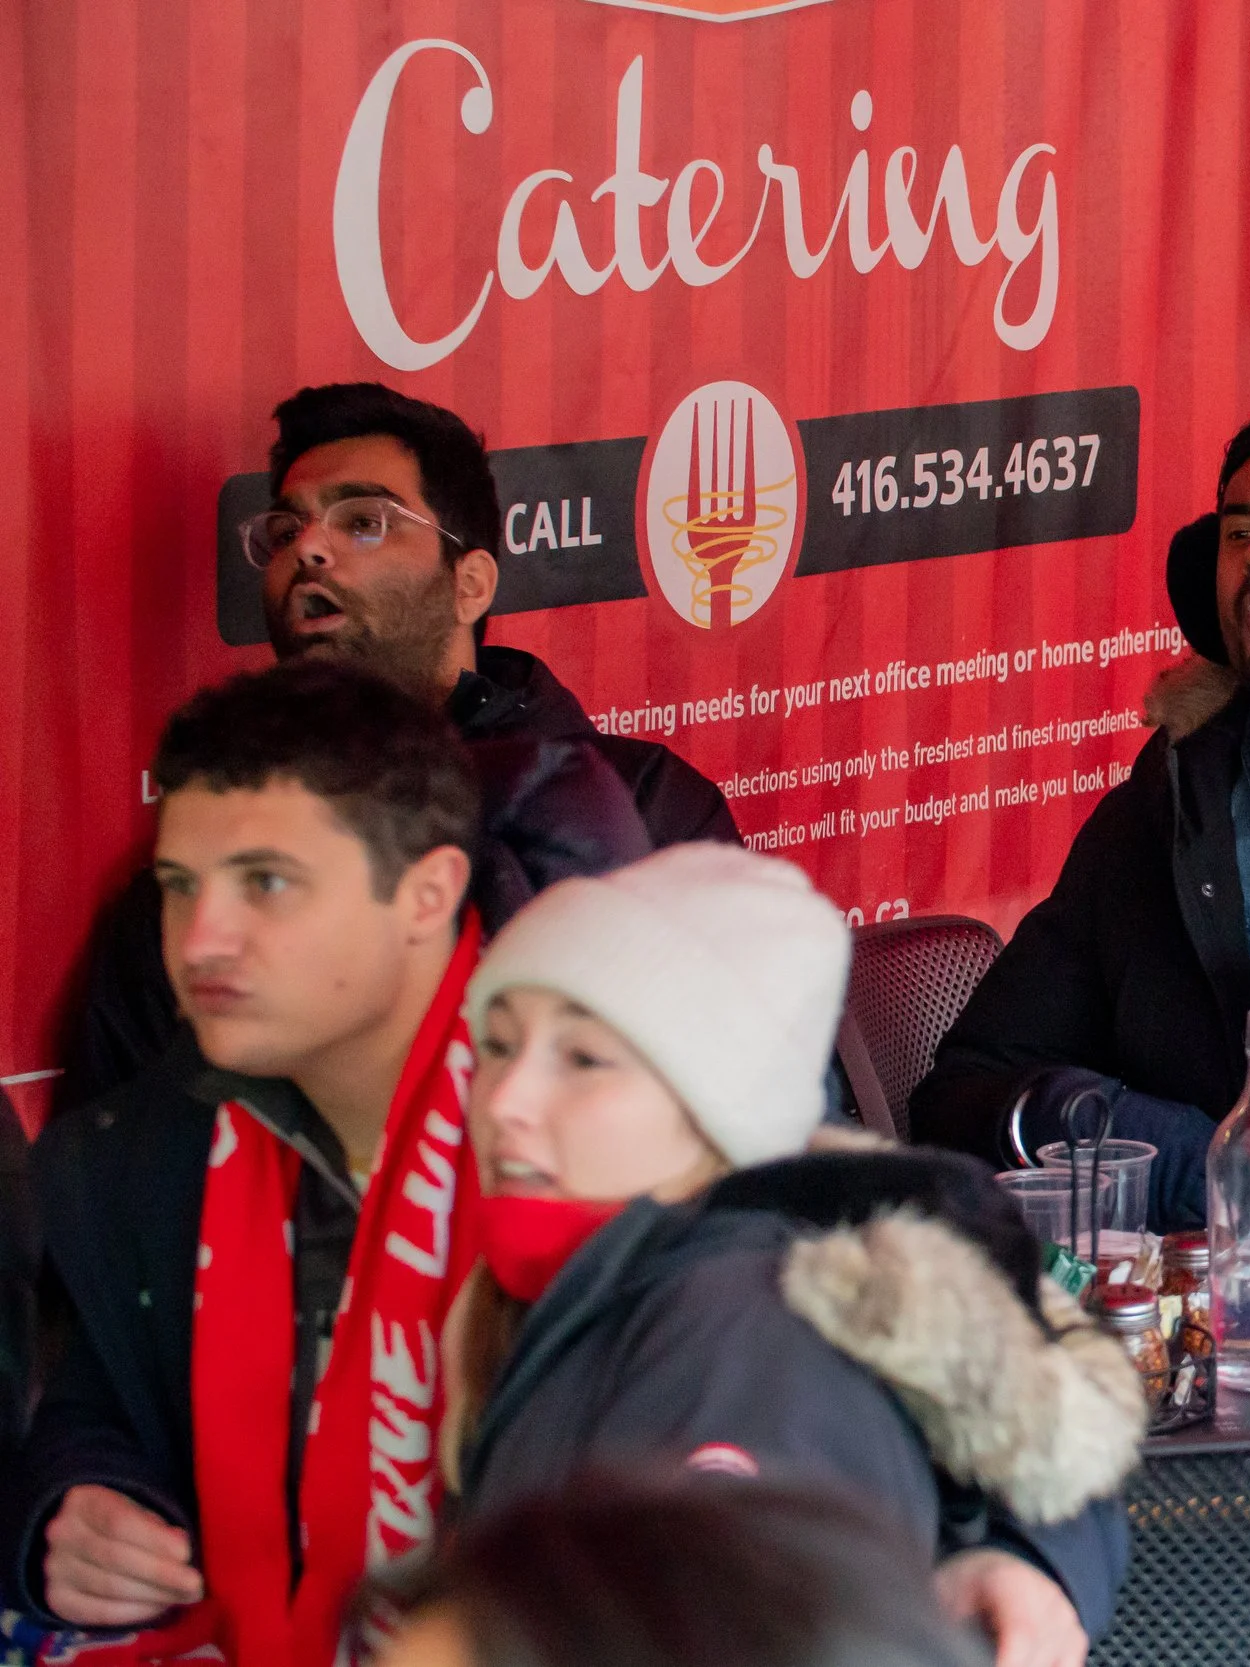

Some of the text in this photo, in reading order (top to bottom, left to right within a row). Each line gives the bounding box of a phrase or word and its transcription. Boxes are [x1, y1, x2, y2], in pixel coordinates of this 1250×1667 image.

[332, 38, 1060, 371] Catering
[505, 433, 1101, 555] CALL 416.534.4637
[587, 699, 676, 737] atering
[682, 687, 745, 726] needs
[749, 683, 781, 716] for
[783, 680, 826, 719] your
[829, 667, 871, 703] next
[874, 659, 931, 695] office
[936, 647, 1009, 687] meeting
[1013, 648, 1038, 673] or
[1041, 639, 1095, 670] home
[801, 757, 842, 787] using
[845, 749, 877, 780] only
[880, 745, 910, 771] the
[913, 734, 975, 767] freshest
[976, 726, 1008, 755] and
[1011, 720, 1054, 750] finest
[1056, 707, 1143, 747] ingredients.
[739, 761, 1133, 852] omatico will fit your budget and make you look like
